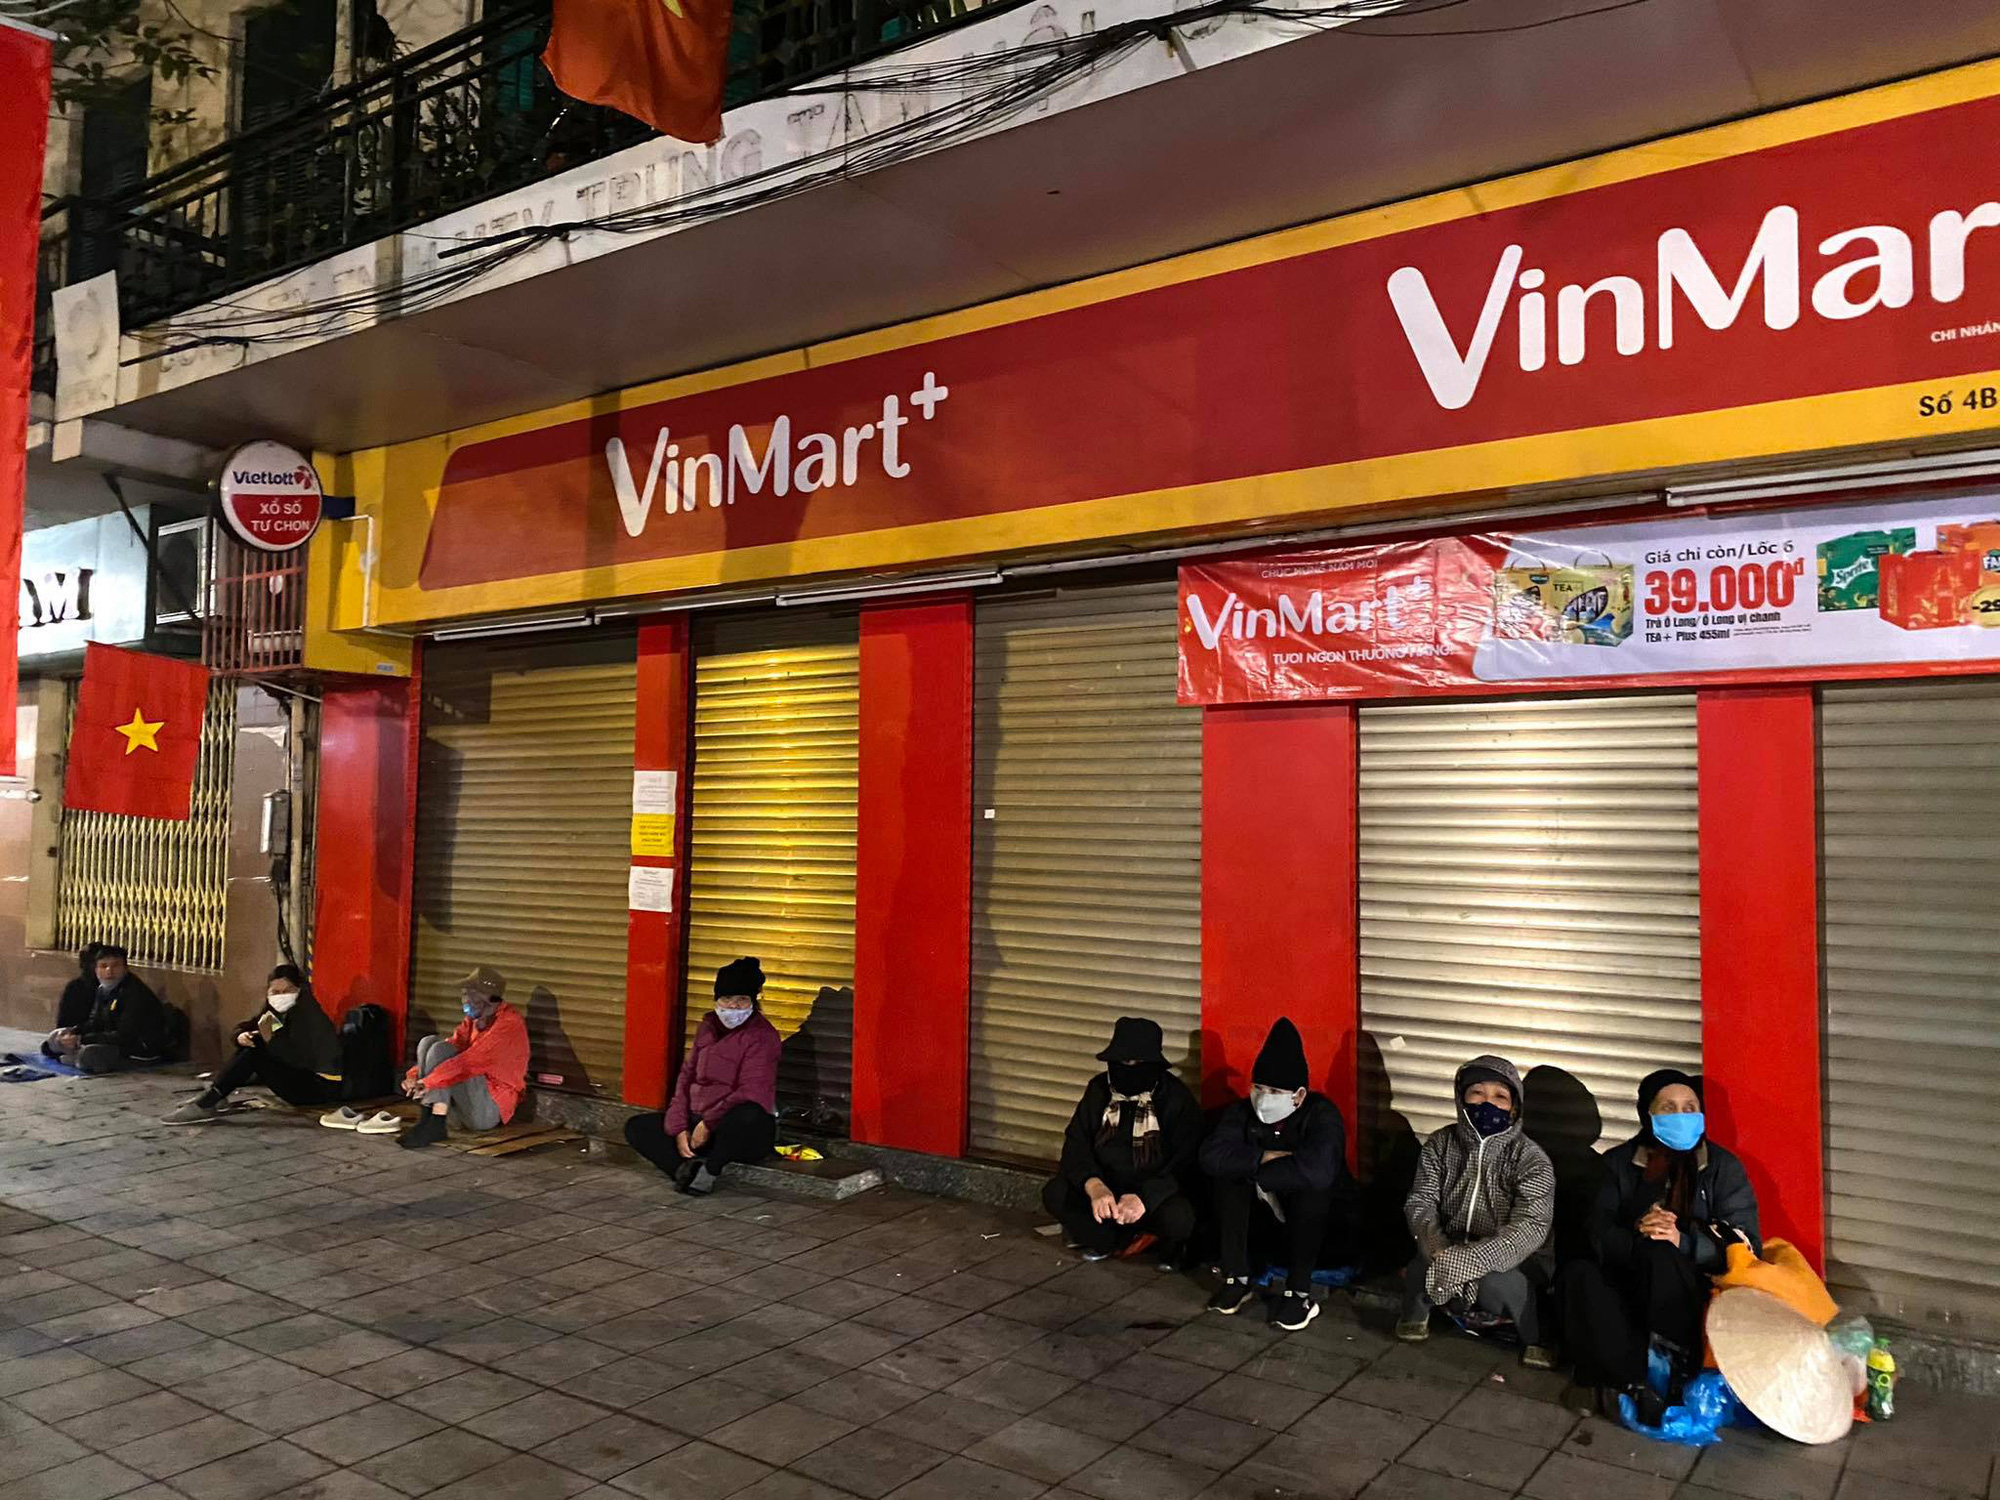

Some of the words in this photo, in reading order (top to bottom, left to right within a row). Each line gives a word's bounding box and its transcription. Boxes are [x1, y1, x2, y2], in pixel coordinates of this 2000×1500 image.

[1930, 328, 1957, 342] CHI
[1919, 390, 1953, 417] Số
[1962, 387, 1997, 411] 4B
[232, 470, 294, 485] Vietlott
[283, 499, 302, 514] SỐ
[1645, 549, 1671, 564] Giá
[1835, 558, 1871, 585] Sprite
[1712, 613, 1735, 625] Long
[1750, 611, 1781, 622] chanh
[1676, 630, 1697, 641] Plus
[1700, 628, 1730, 640] 455ml
